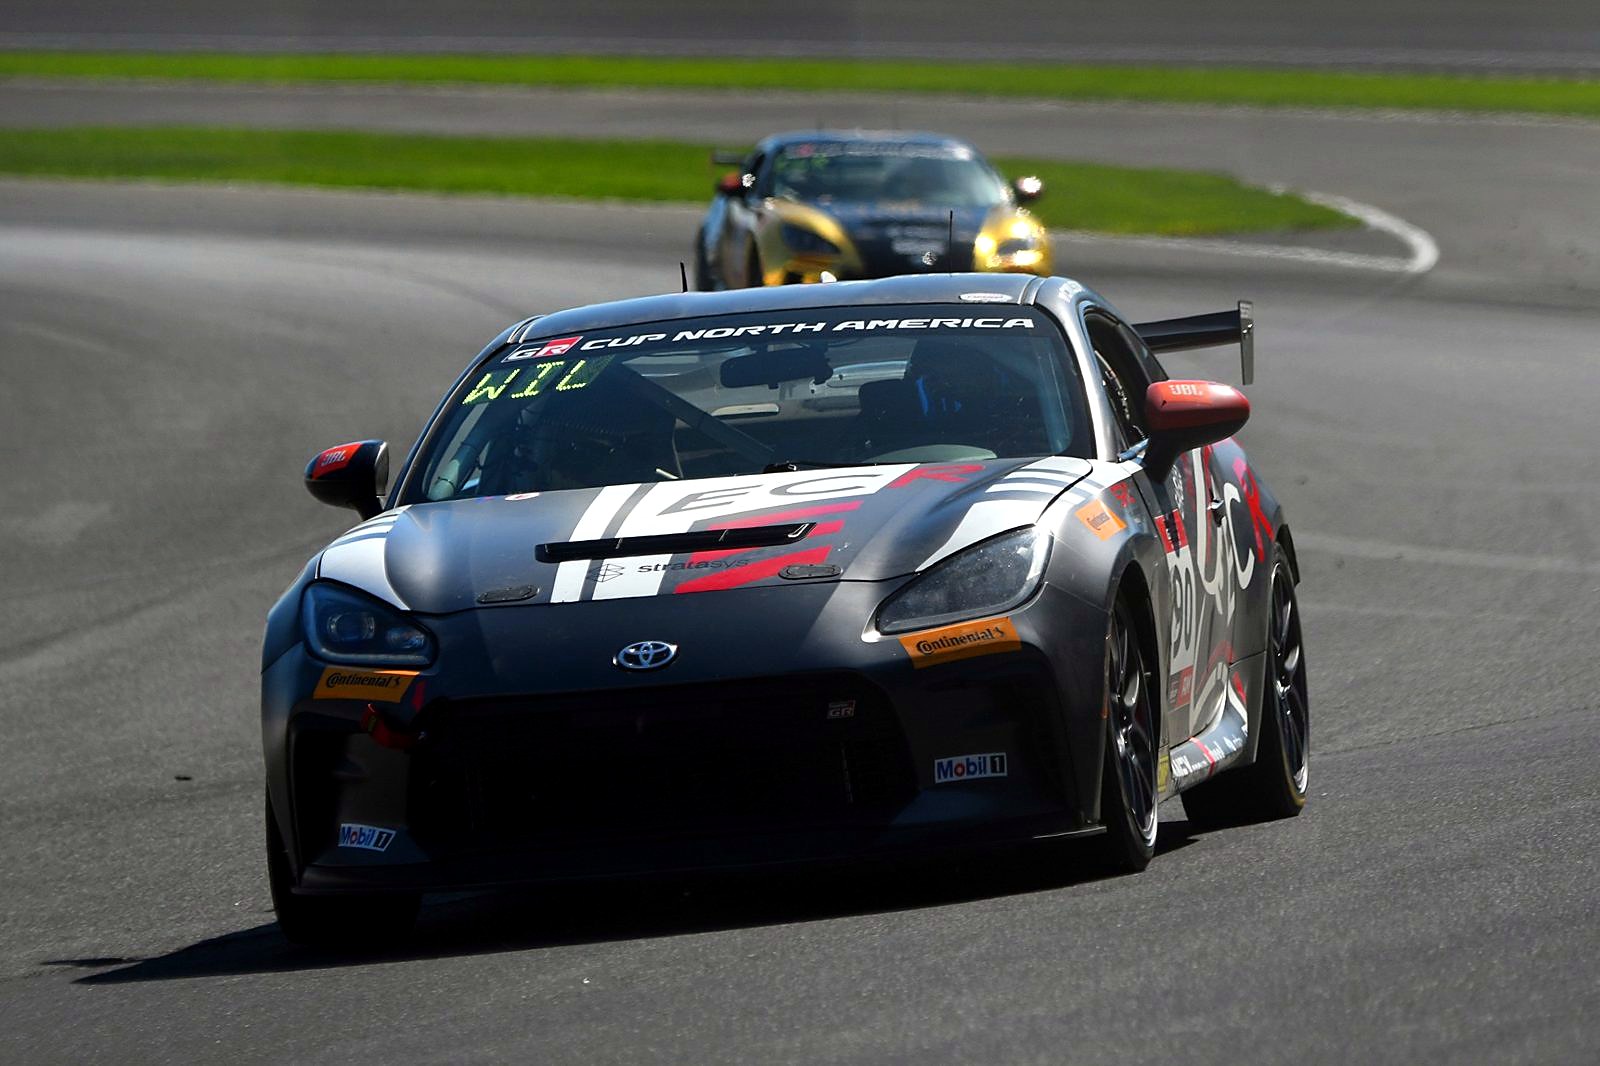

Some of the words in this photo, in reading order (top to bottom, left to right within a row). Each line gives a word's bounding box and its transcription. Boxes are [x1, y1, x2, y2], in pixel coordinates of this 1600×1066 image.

[505, 341, 569, 362] GR
[580, 333, 667, 350] CUP
[672, 322, 825, 342] NORTH
[832, 318, 1034, 331] AMERICA
[463, 359, 586, 404] WIL
[1168, 384, 1203, 396] JBL
[321, 450, 346, 467] JBL
[637, 558, 749, 573] stratasys
[916, 627, 994, 655] Continental
[326, 672, 392, 688] Continental
[936, 756, 988, 781] Mobil
[341, 826, 376, 846] Mobil
